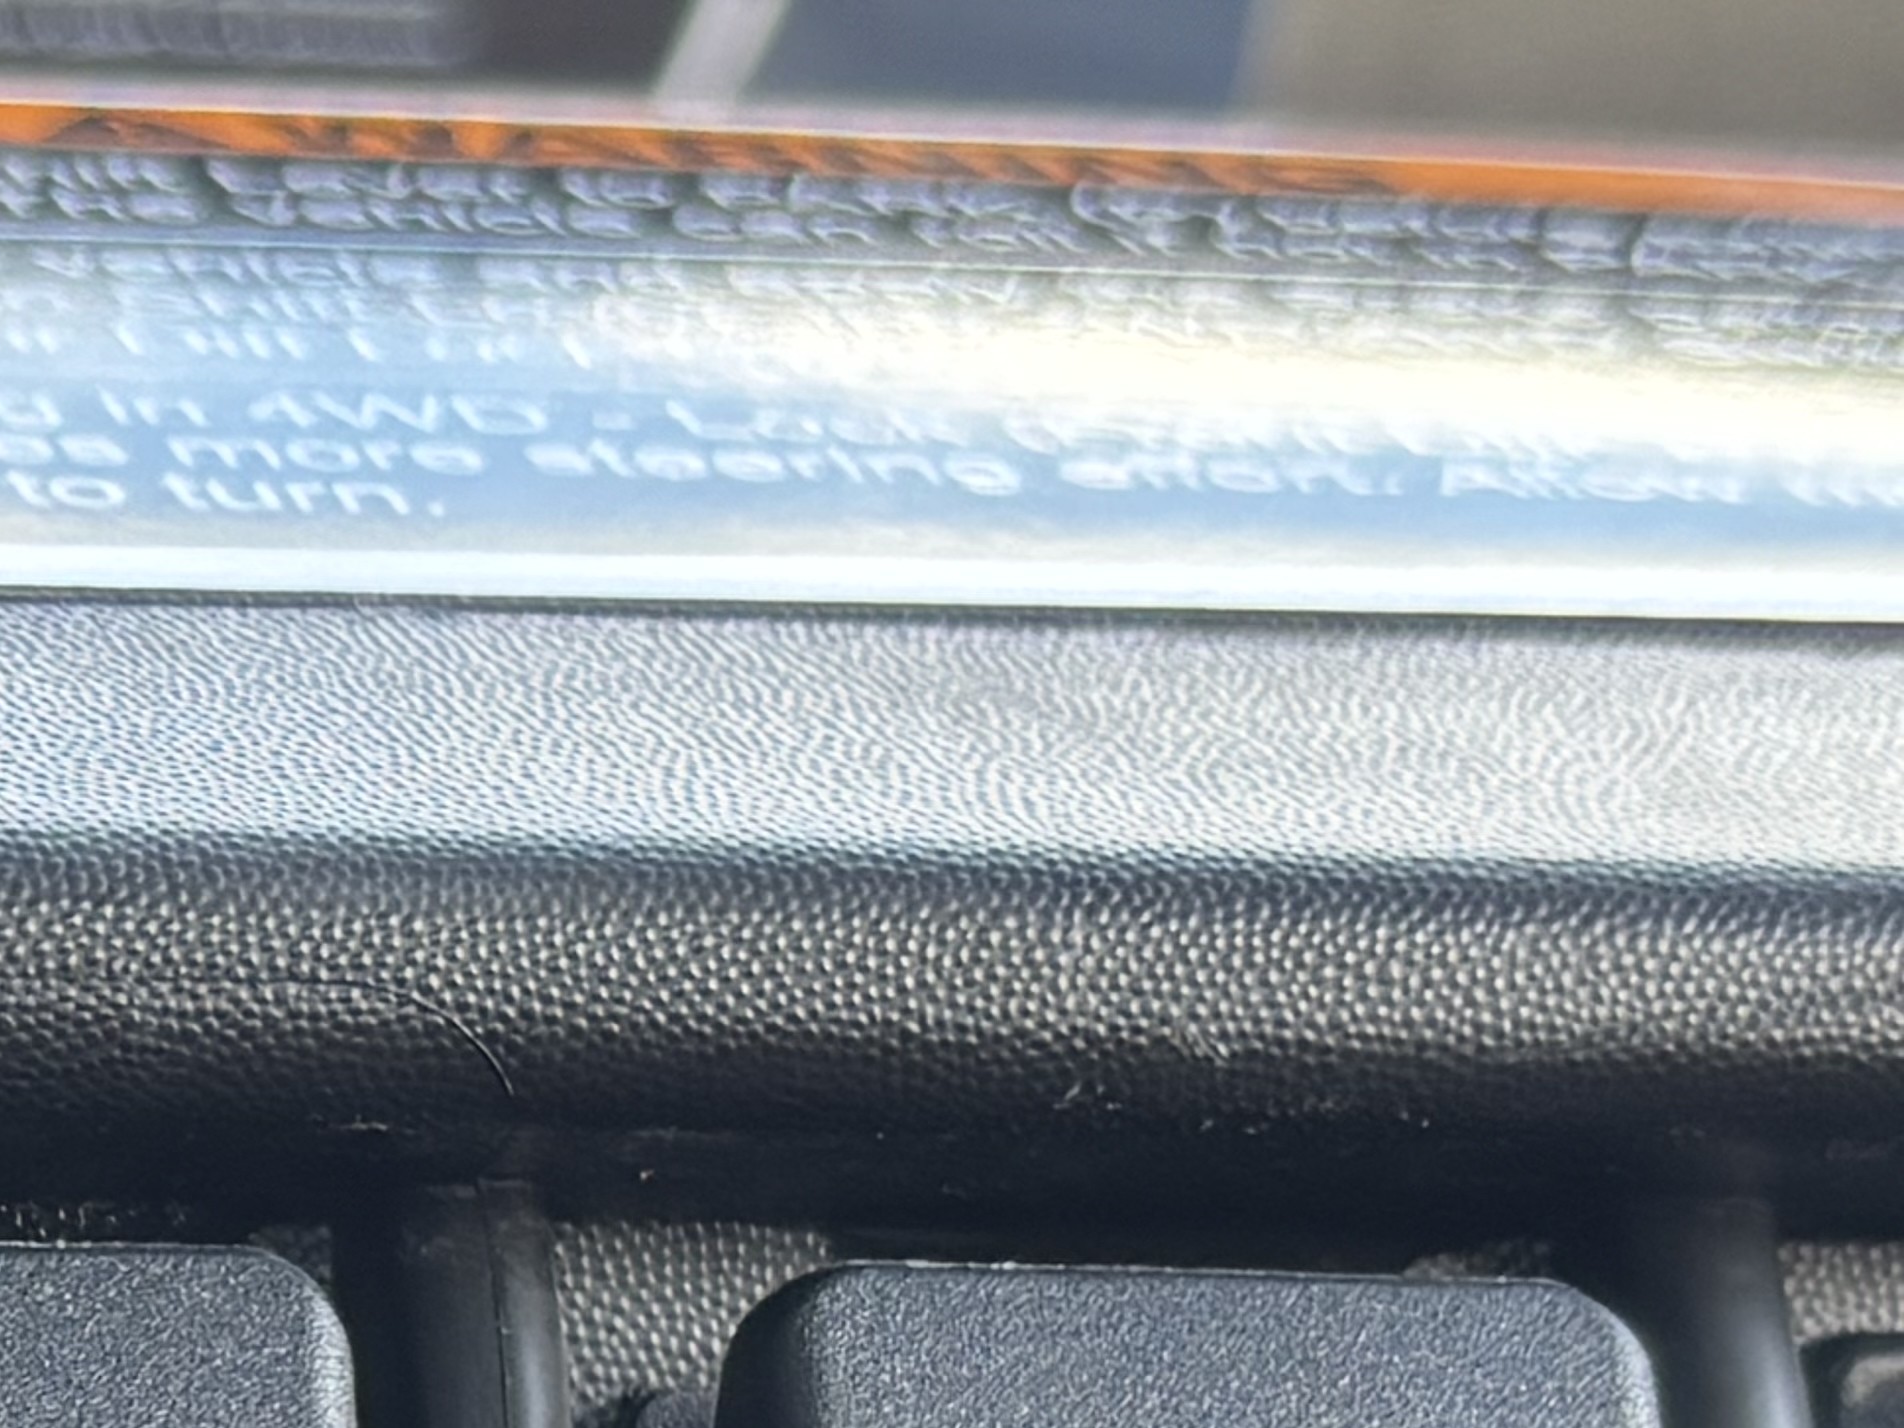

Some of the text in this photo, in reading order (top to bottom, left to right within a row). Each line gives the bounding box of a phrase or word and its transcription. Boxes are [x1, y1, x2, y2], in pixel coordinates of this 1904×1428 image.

[97, 383, 210, 422] in
[248, 384, 550, 431] 4WD
[167, 434, 487, 472] more
[7, 468, 130, 503] to
[162, 470, 450, 514] turn.
